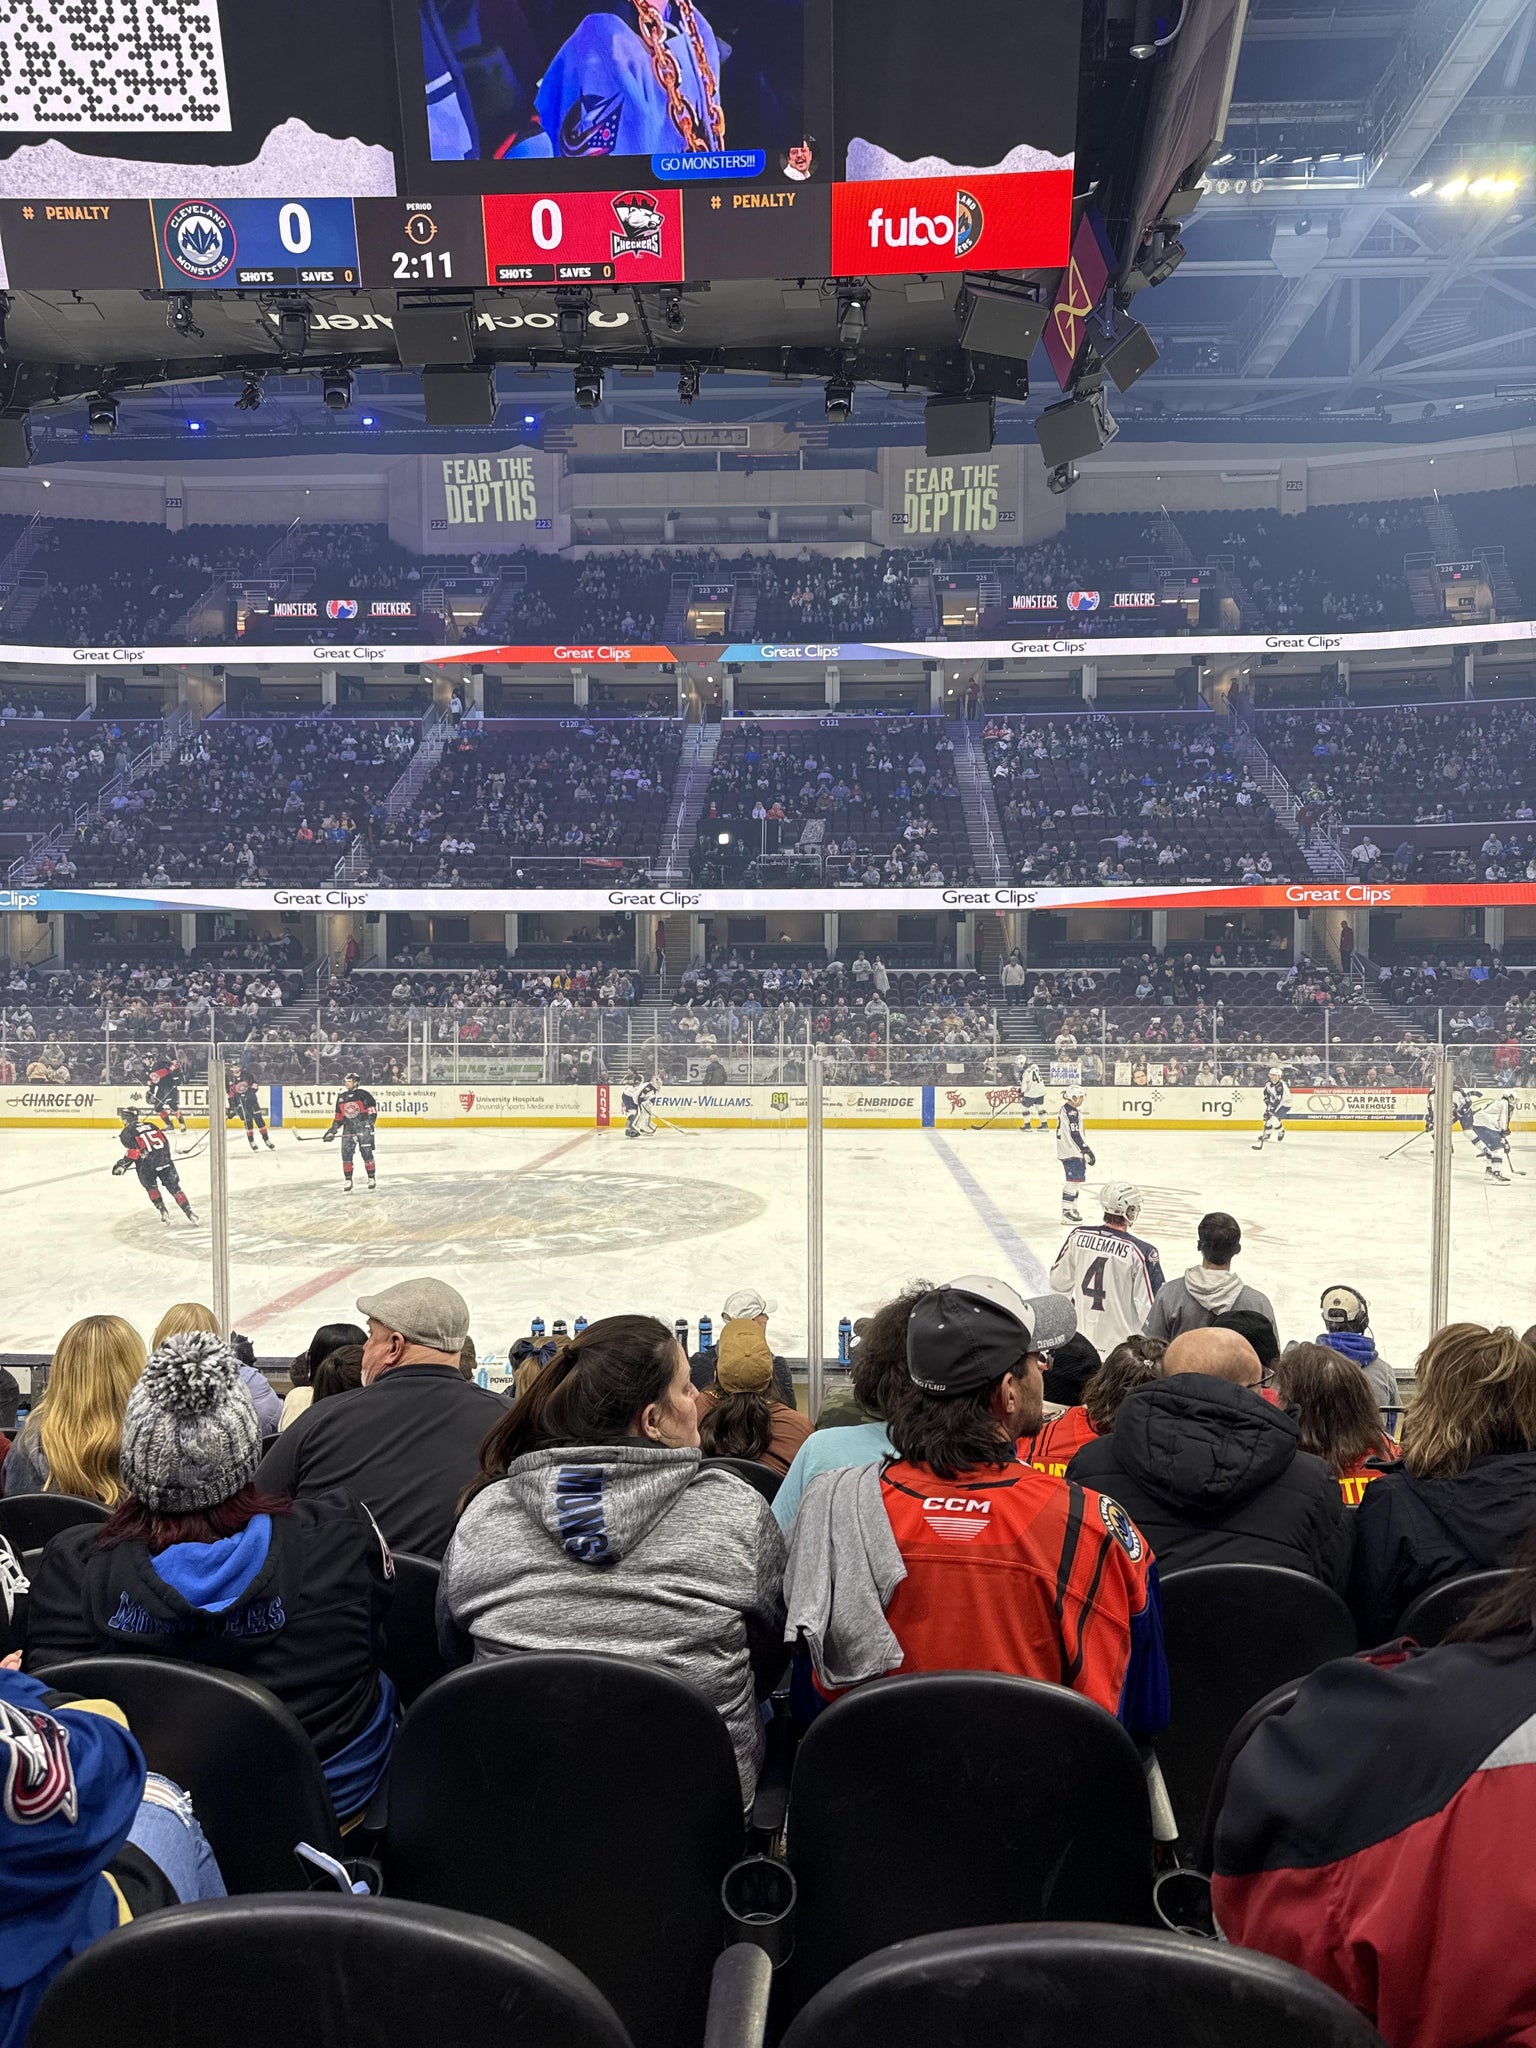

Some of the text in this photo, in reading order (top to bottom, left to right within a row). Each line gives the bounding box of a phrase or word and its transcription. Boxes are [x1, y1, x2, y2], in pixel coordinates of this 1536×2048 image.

[660, 155, 756, 171] GO MONSTERS!!!
[406, 203, 432, 211] PERIOD
[733, 192, 796, 209] PENALTY
[45, 206, 110, 220] PENALTY
[170, 205, 227, 230] CLEVELAND
[278, 202, 312, 254] 0
[416, 222, 424, 234] 1
[530, 198, 563, 250] 0
[868, 207, 954, 248] fubo
[176, 255, 229, 276] MONSTERS
[391, 250, 452, 279] 2:11
[559, 264, 612, 278] SAVES 0
[240, 271, 275, 282] SHOTS
[301, 269, 353, 282] SAVES 0
[499, 268, 533, 279] SHOTS
[442, 457, 534, 484] FEAR THE
[904, 464, 1000, 493] FEAR THE
[166, 498, 182, 508] 221
[444, 480, 537, 524] DEPTHS
[903, 487, 998, 534] DEPTHS
[999, 512, 1015, 521] 225
[431, 521, 447, 529] 222
[536, 520, 552, 529] 223
[892, 514, 908, 523] 224
[1012, 594, 1058, 609] MONSTERS
[1113, 592, 1155, 607] CHECKERS
[274, 602, 318, 616] MONSTERS
[371, 602, 411, 615] CHECKERS
[1011, 640, 1085, 655] Great Clips
[1265, 635, 1341, 650] Great Clips
[73, 649, 143, 662] Great Clips
[313, 647, 384, 661] Great Clips
[554, 646, 631, 661] Great Clips
[761, 645, 839, 660] Great Clips
[559, 720, 579, 728] C 120
[819, 719, 839, 727] C 121
[273, 890, 366, 908] Great Clips
[608, 890, 699, 909] Great Clips
[942, 889, 1036, 908] Great Clips
[1286, 885, 1391, 904] Great Clips
[22, 1093, 95, 1107] CHARGE ON
[385, 1089, 406, 1098] tequila
[413, 1088, 437, 1098] whiskey
[476, 1096, 545, 1105] University Hospitals
[772, 1092, 789, 1105] 811
[395, 1099, 429, 1116] slaps
[506, 1103, 527, 1111] Sports
[599, 1087, 608, 1119] CCM
[857, 1097, 914, 1107] ENBRIDGE
[1122, 1100, 1153, 1116] nrg
[1202, 1100, 1233, 1117] nrg
[139, 1130, 165, 1152] 15
[1077, 1234, 1130, 1259] CEULEMANS
[1081, 1256, 1109, 1312] 4
[922, 1497, 991, 1514] CCM
